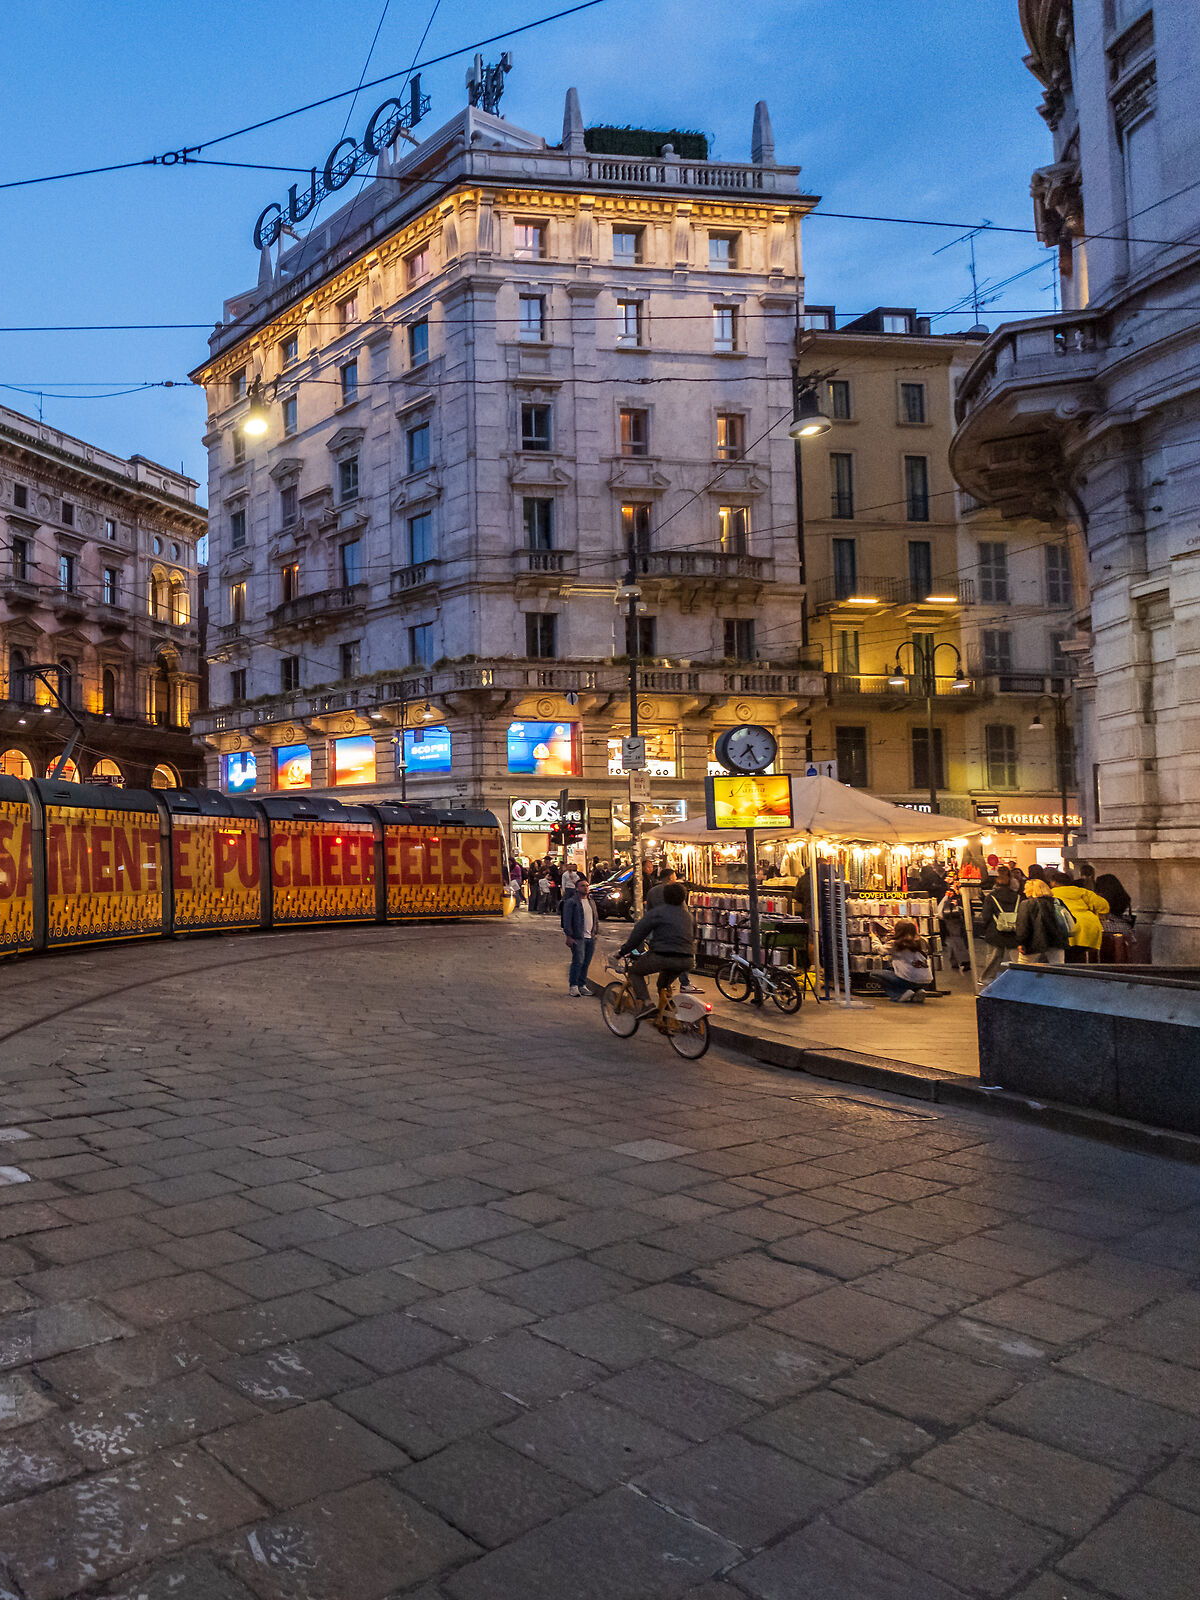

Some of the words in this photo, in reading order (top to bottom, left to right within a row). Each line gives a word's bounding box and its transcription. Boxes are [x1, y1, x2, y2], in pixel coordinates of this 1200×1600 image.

[253, 73, 422, 250] GUCCI
[859, 891, 886, 899] COVER
[886, 891, 908, 899] POINT
